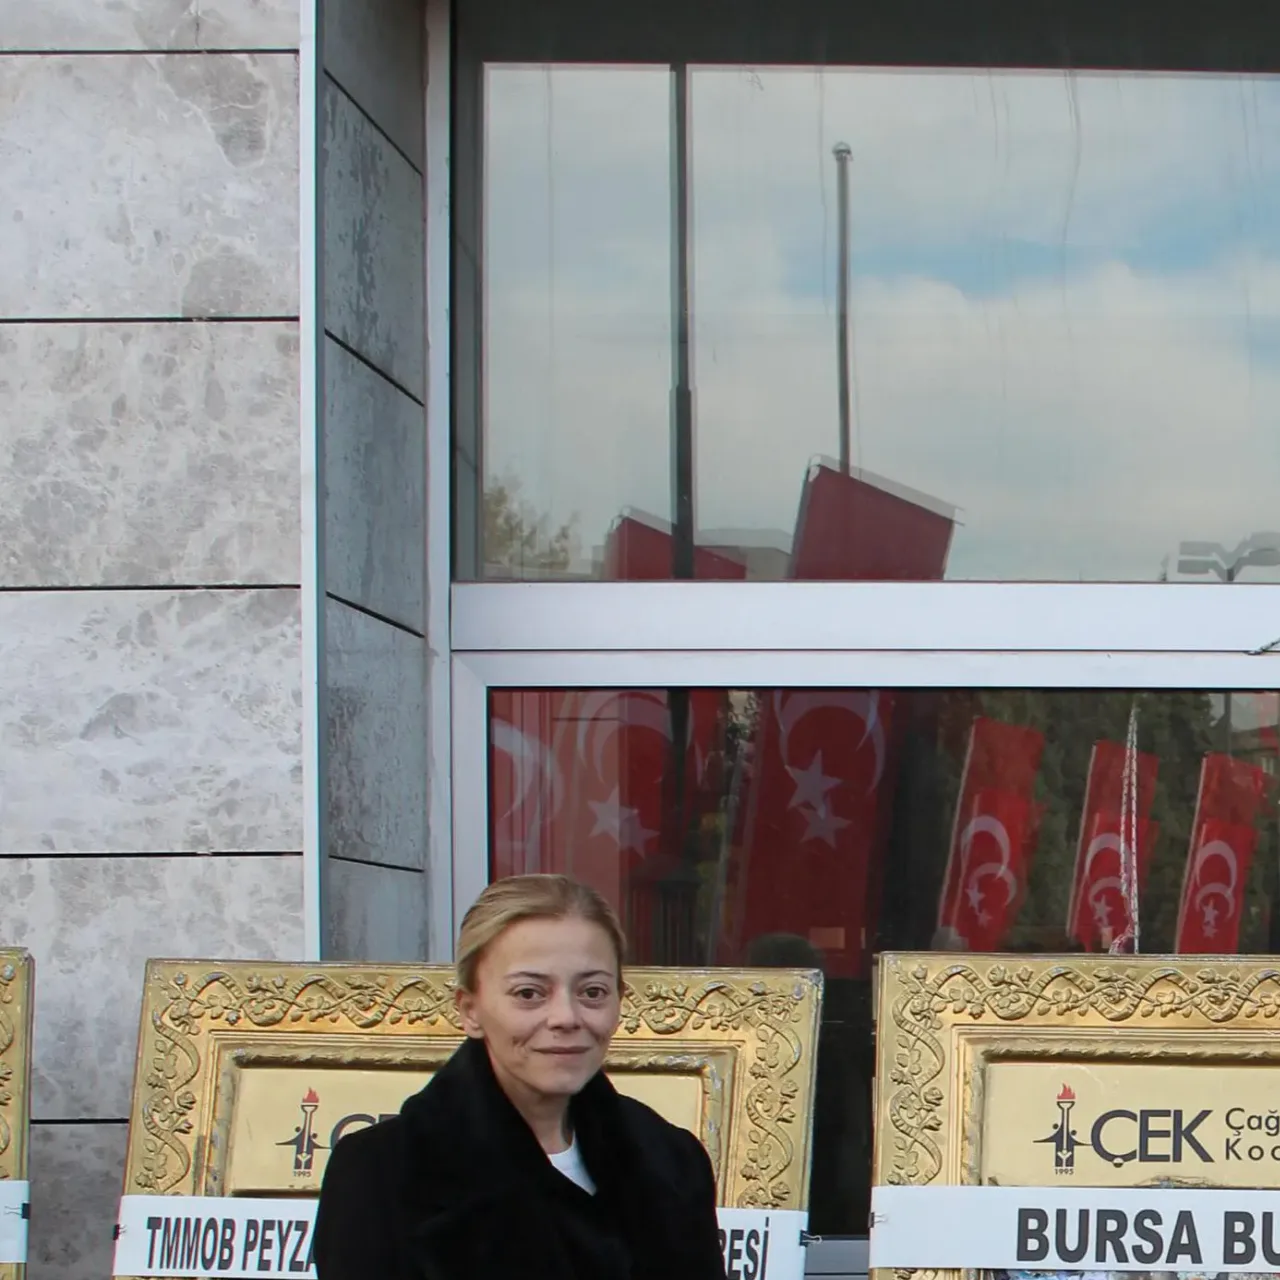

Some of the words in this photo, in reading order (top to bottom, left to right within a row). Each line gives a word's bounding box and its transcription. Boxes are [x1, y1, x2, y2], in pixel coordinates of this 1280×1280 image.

[1091, 1109, 1215, 1168] ÇEK
[292, 1170, 312, 1178] 1995
[1055, 1168, 1074, 1176] 1995
[146, 1216, 236, 1271] TMMOB
[1016, 1207, 1203, 1266] BURSA
